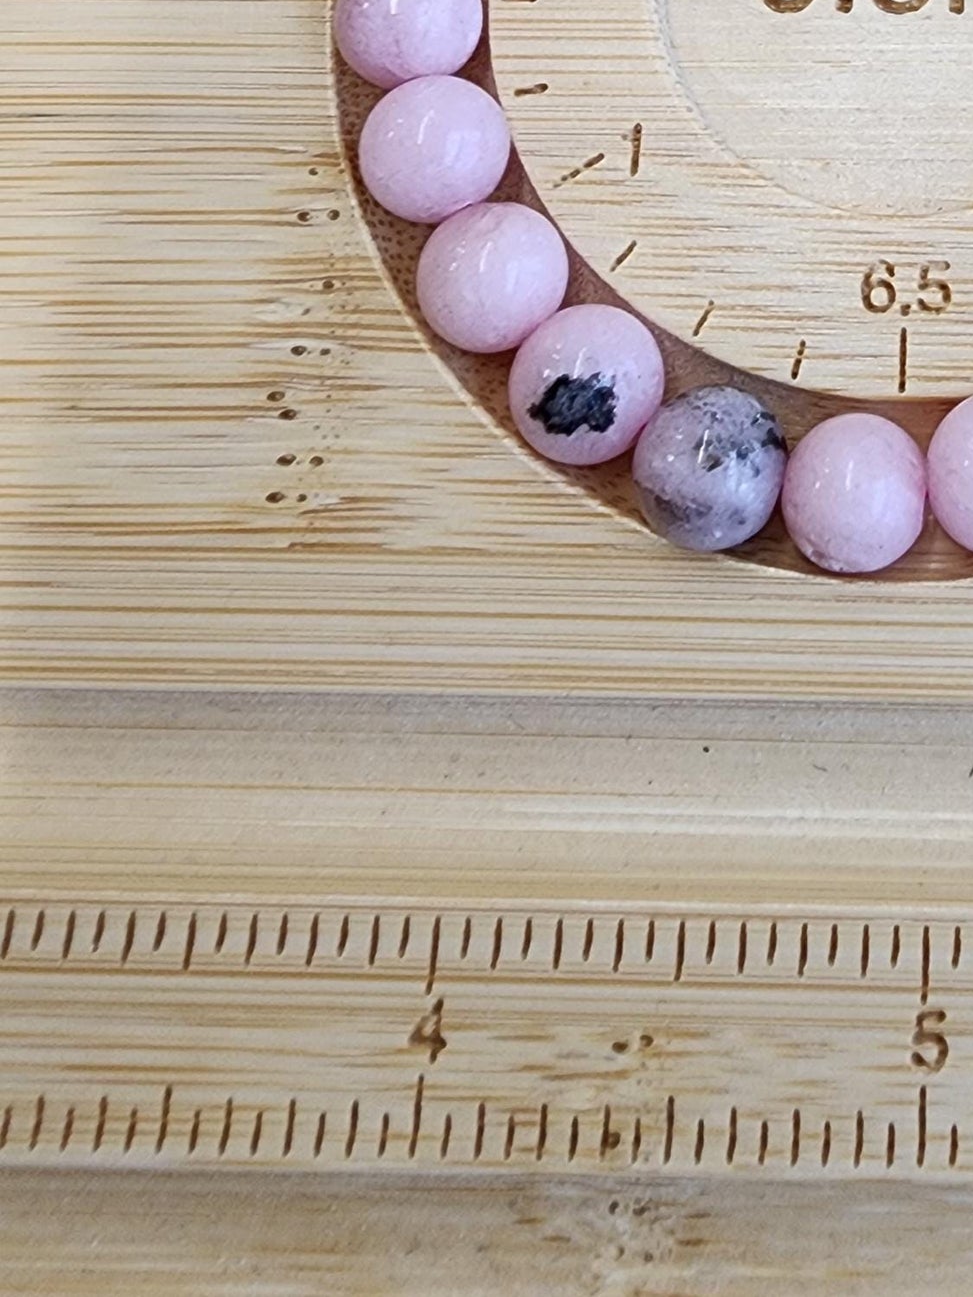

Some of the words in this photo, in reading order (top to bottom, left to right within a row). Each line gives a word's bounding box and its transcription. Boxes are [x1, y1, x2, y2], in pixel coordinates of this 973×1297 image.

[622, 123, 641, 175] 1
[860, 261, 951, 316] 6.5
[409, 998, 447, 1064] 4
[910, 1009, 948, 1072] 5
